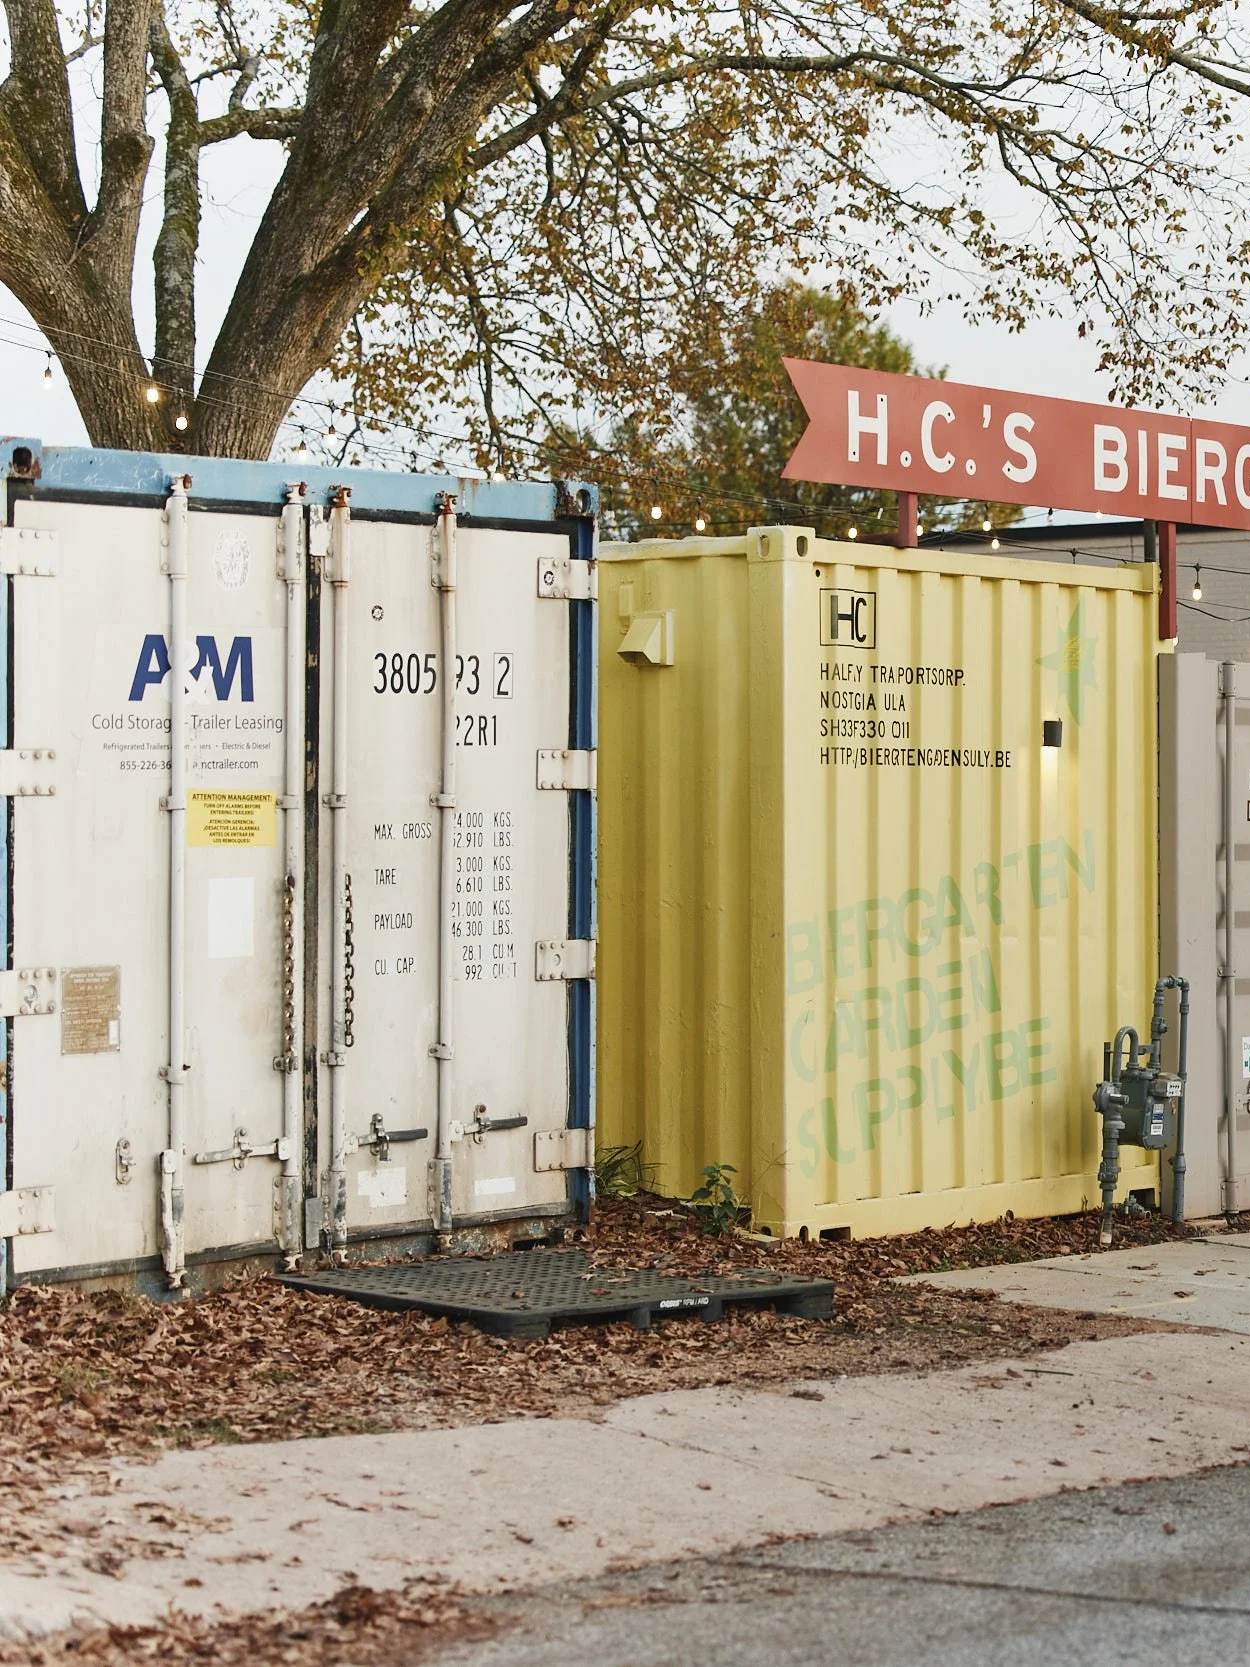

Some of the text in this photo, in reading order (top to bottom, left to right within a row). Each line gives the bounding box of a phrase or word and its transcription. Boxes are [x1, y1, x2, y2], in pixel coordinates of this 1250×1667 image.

[848, 390, 1037, 483] H.C.'S
[831, 595, 866, 642] HC
[497, 656, 510, 696] 2
[92, 714, 123, 729] Cold
[128, 714, 172, 733] Storag
[191, 714, 232, 729] Trailer
[235, 714, 283, 733] Leasing
[103, 743, 145, 751] Refrigerated
[222, 742, 245, 750] Electric
[252, 742, 271, 750] Diesel
[120, 760, 172, 770] 855-226-36
[192, 793, 227, 801] ATTENTION
[493, 812, 514, 828] KGS.
[374, 822, 432, 840] MAX. GROSS
[493, 832, 514, 847] LBS.
[456, 855, 514, 873] 3.000 KGS.
[375, 868, 397, 885] TARE
[456, 875, 513, 893] 6.610 LBS.
[492, 900, 513, 916] KGS.
[374, 912, 413, 930] PAYLOAD
[492, 920, 513, 936] LBS.
[463, 945, 482, 961] 28.1
[374, 957, 416, 976] CU. CAP.
[465, 964, 482, 980] 992
